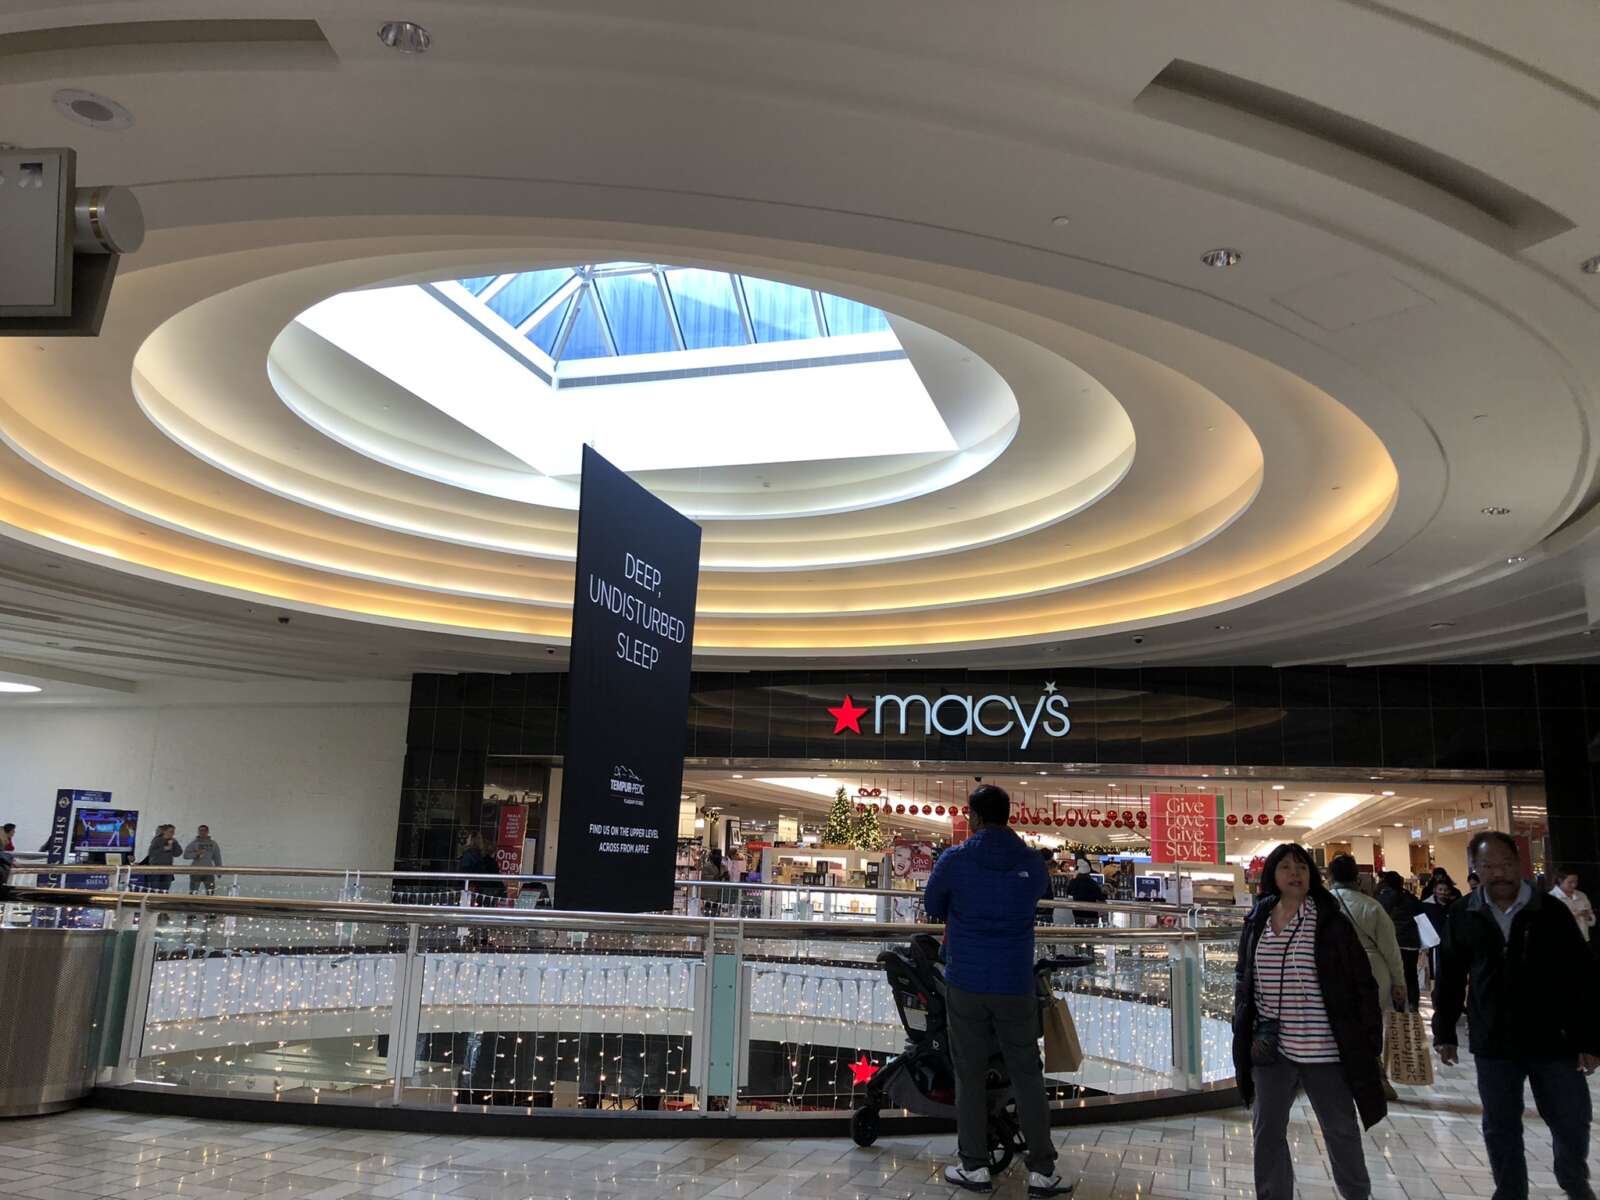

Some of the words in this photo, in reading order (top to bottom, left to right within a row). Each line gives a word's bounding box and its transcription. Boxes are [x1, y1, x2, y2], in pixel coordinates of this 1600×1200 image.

[624, 553, 662, 598] DEEP,
[589, 574, 685, 643] UNDISTURBED
[616, 632, 659, 670] SLEEP
[874, 680, 1071, 749] macy's
[1166, 798, 1204, 813] Give
[1166, 811, 1209, 828] Love.
[52, 816, 66, 856] SHEN
[589, 823, 602, 834] FIND
[603, 825, 610, 835] US
[610, 826, 619, 836] ON
[620, 827, 629, 836] THE
[629, 828, 645, 838] UPPER
[645, 829, 659, 839] LEVEL
[1167, 825, 1204, 841] Give
[496, 849, 518, 860] One
[599, 842, 620, 852] ACROSS
[620, 843, 635, 853] FROM
[635, 844, 650, 854] APPLE
[1166, 841, 1211, 860] Style.
[502, 860, 522, 873] Day
